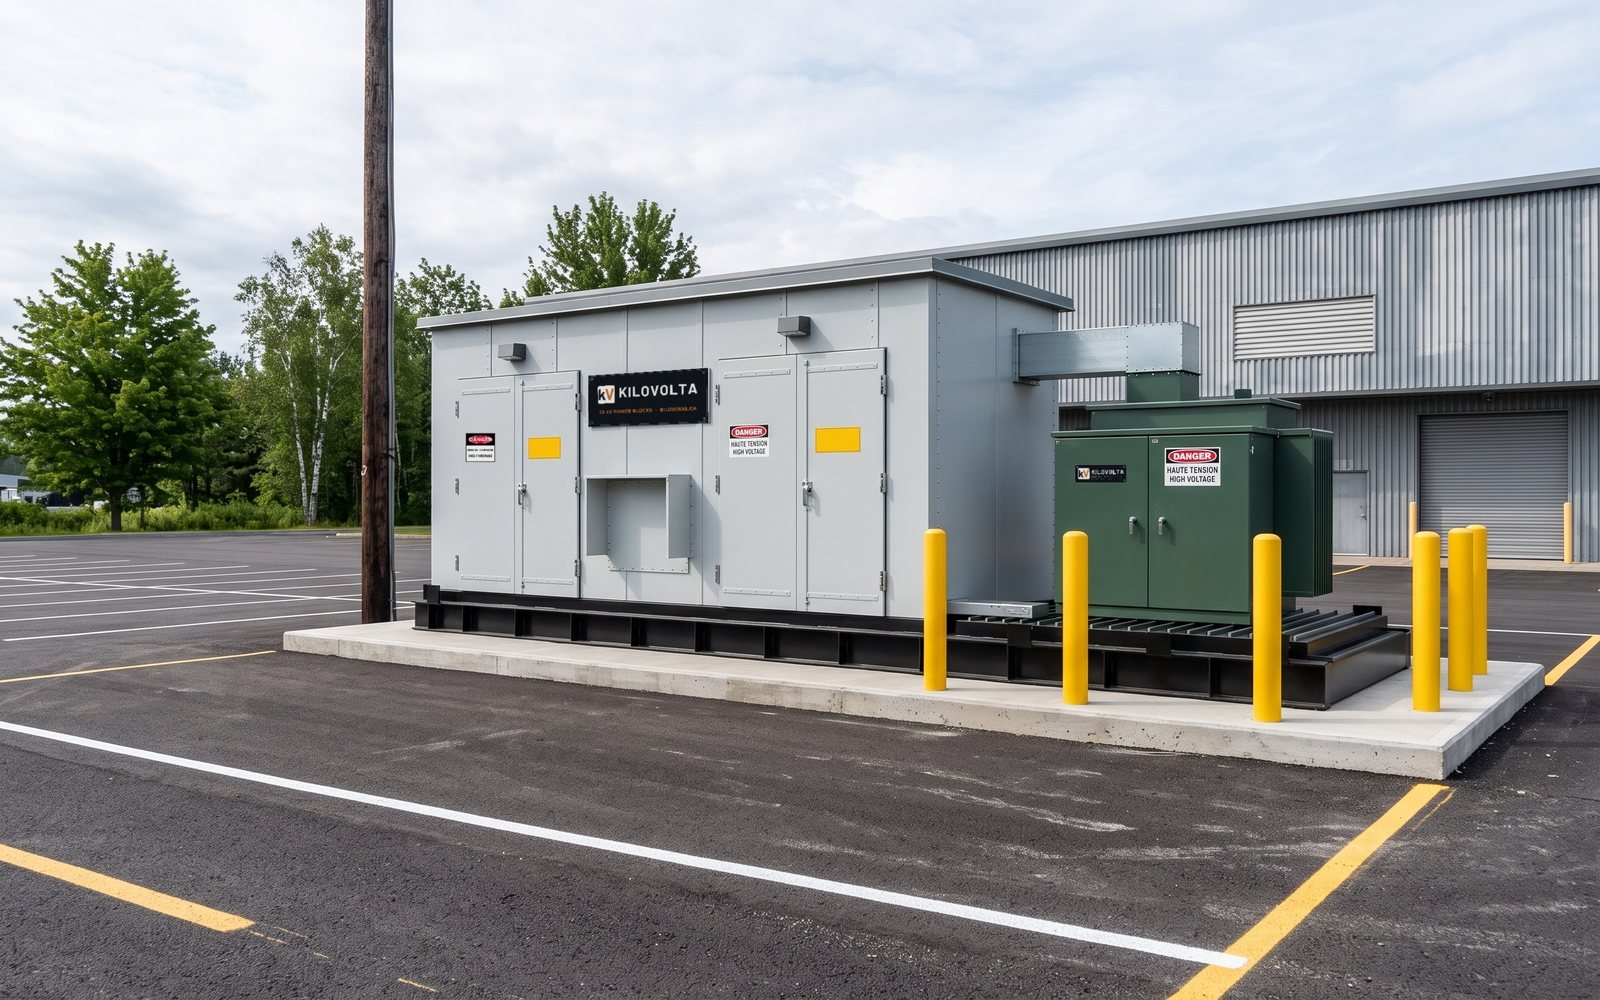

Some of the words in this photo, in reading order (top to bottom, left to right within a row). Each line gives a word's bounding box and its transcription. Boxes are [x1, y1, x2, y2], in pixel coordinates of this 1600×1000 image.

[598, 387, 614, 401] kV
[619, 383, 698, 398] KILOVOLTA
[735, 428, 763, 436] DANGER
[1173, 452, 1212, 460] DANGER
[1079, 470, 1089, 478] kV
[1190, 466, 1218, 474] TENSION
[1187, 475, 1216, 483] VOLTAGE
